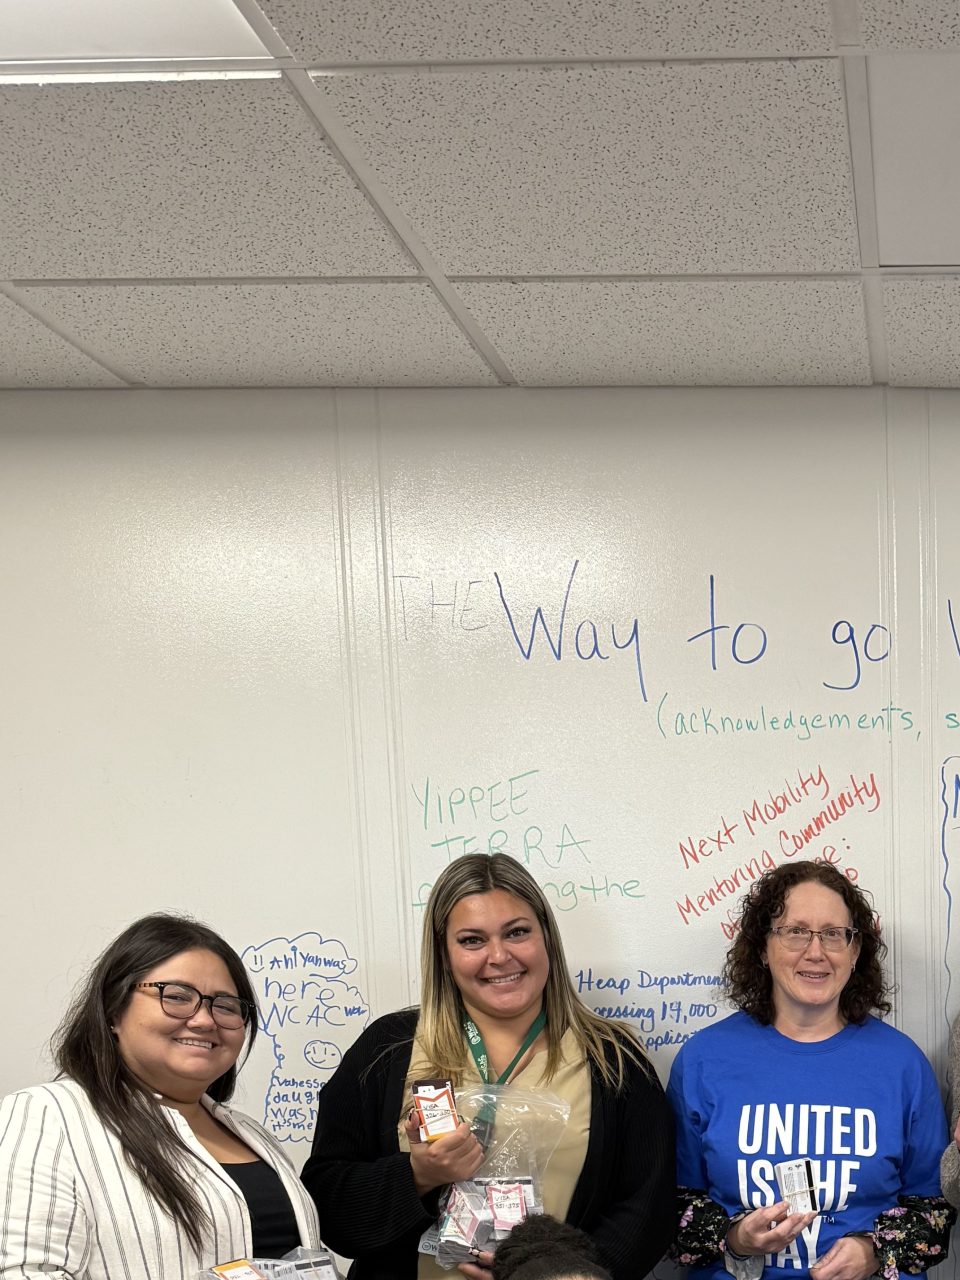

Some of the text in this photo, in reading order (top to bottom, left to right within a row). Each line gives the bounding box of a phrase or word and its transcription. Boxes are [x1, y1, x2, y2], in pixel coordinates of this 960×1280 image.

[494, 559, 649, 702] Way
[687, 573, 768, 671] to
[822, 619, 893, 690] go
[677, 814, 739, 871] Next
[742, 763, 831, 837] Mobility
[777, 772, 882, 859] Community
[264, 976, 335, 1008] here
[574, 967, 631, 996] Heap
[257, 1001, 346, 1031] WCAC
[737, 1102, 878, 1158] UNITED
